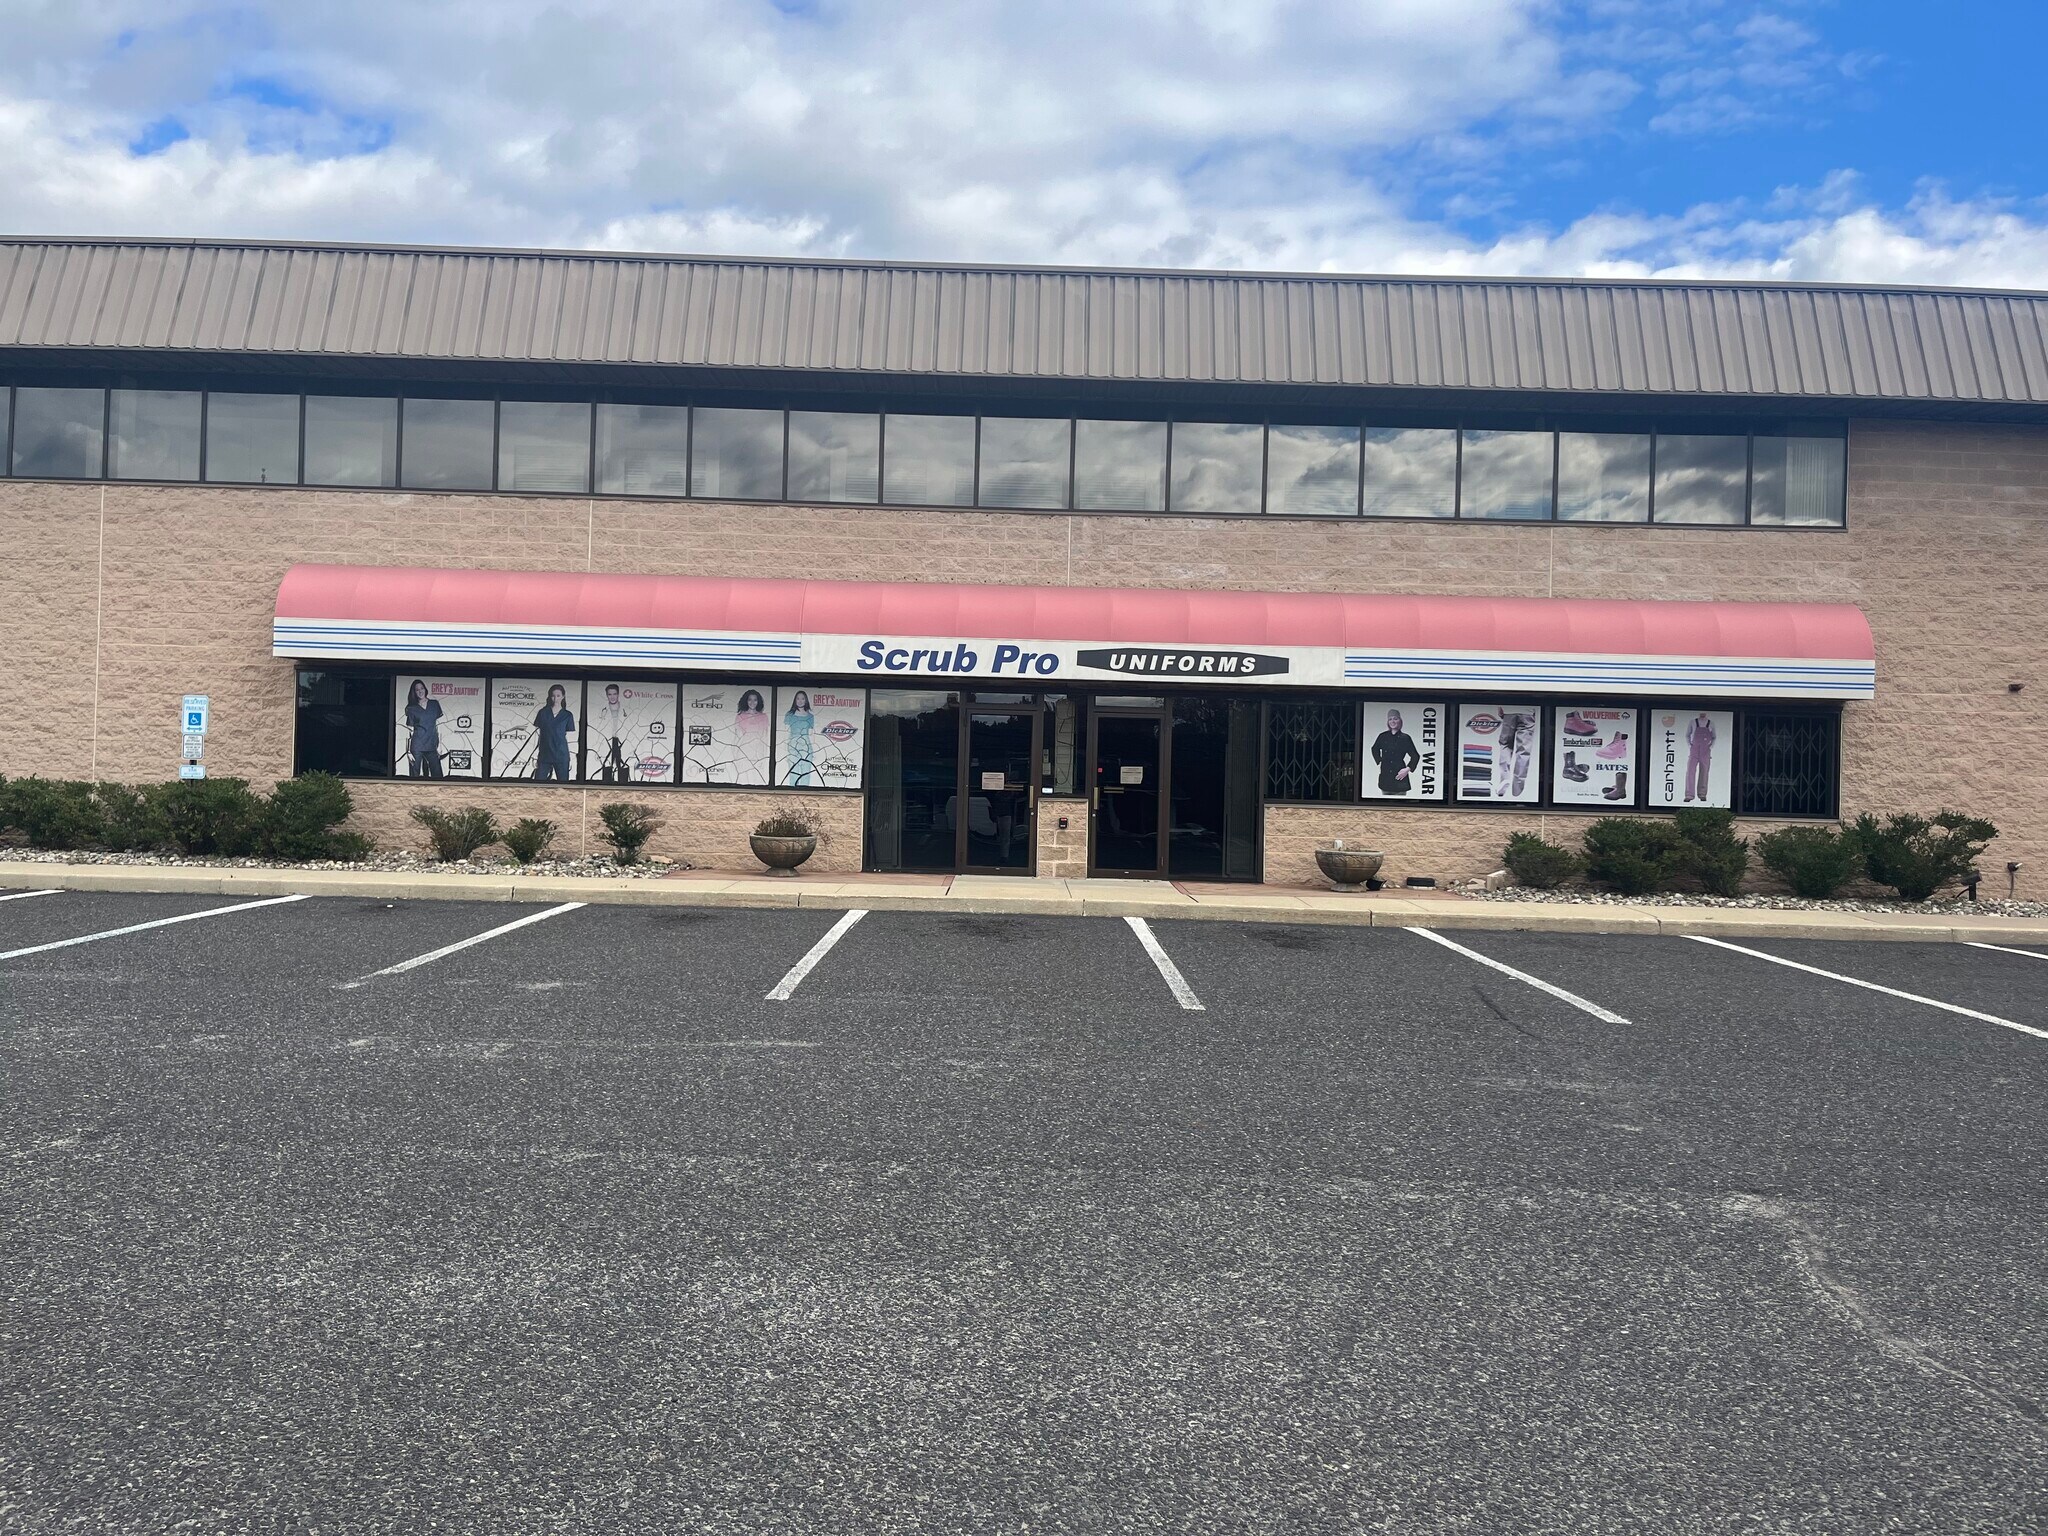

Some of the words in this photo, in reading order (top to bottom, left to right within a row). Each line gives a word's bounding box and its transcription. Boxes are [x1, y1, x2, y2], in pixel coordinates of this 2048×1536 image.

[857, 640, 978, 673] Scrub
[991, 644, 1060, 675] Pro
[1109, 653, 1257, 672] UNIFORMS
[431, 683, 454, 694] GREY'S
[453, 687, 480, 696] ANATOMY
[497, 692, 535, 700] CHEROKEE
[691, 699, 723, 709] dansko
[813, 694, 836, 706] GREY'S
[835, 699, 861, 708] ANATOMY
[1582, 711, 1621, 720] WOLVERINE
[1422, 707, 1436, 747] CHEF
[495, 730, 527, 741] dansko
[1562, 738, 1591, 746] Timberland
[1421, 751, 1435, 794] WEAR
[1664, 730, 1676, 802] carhartt
